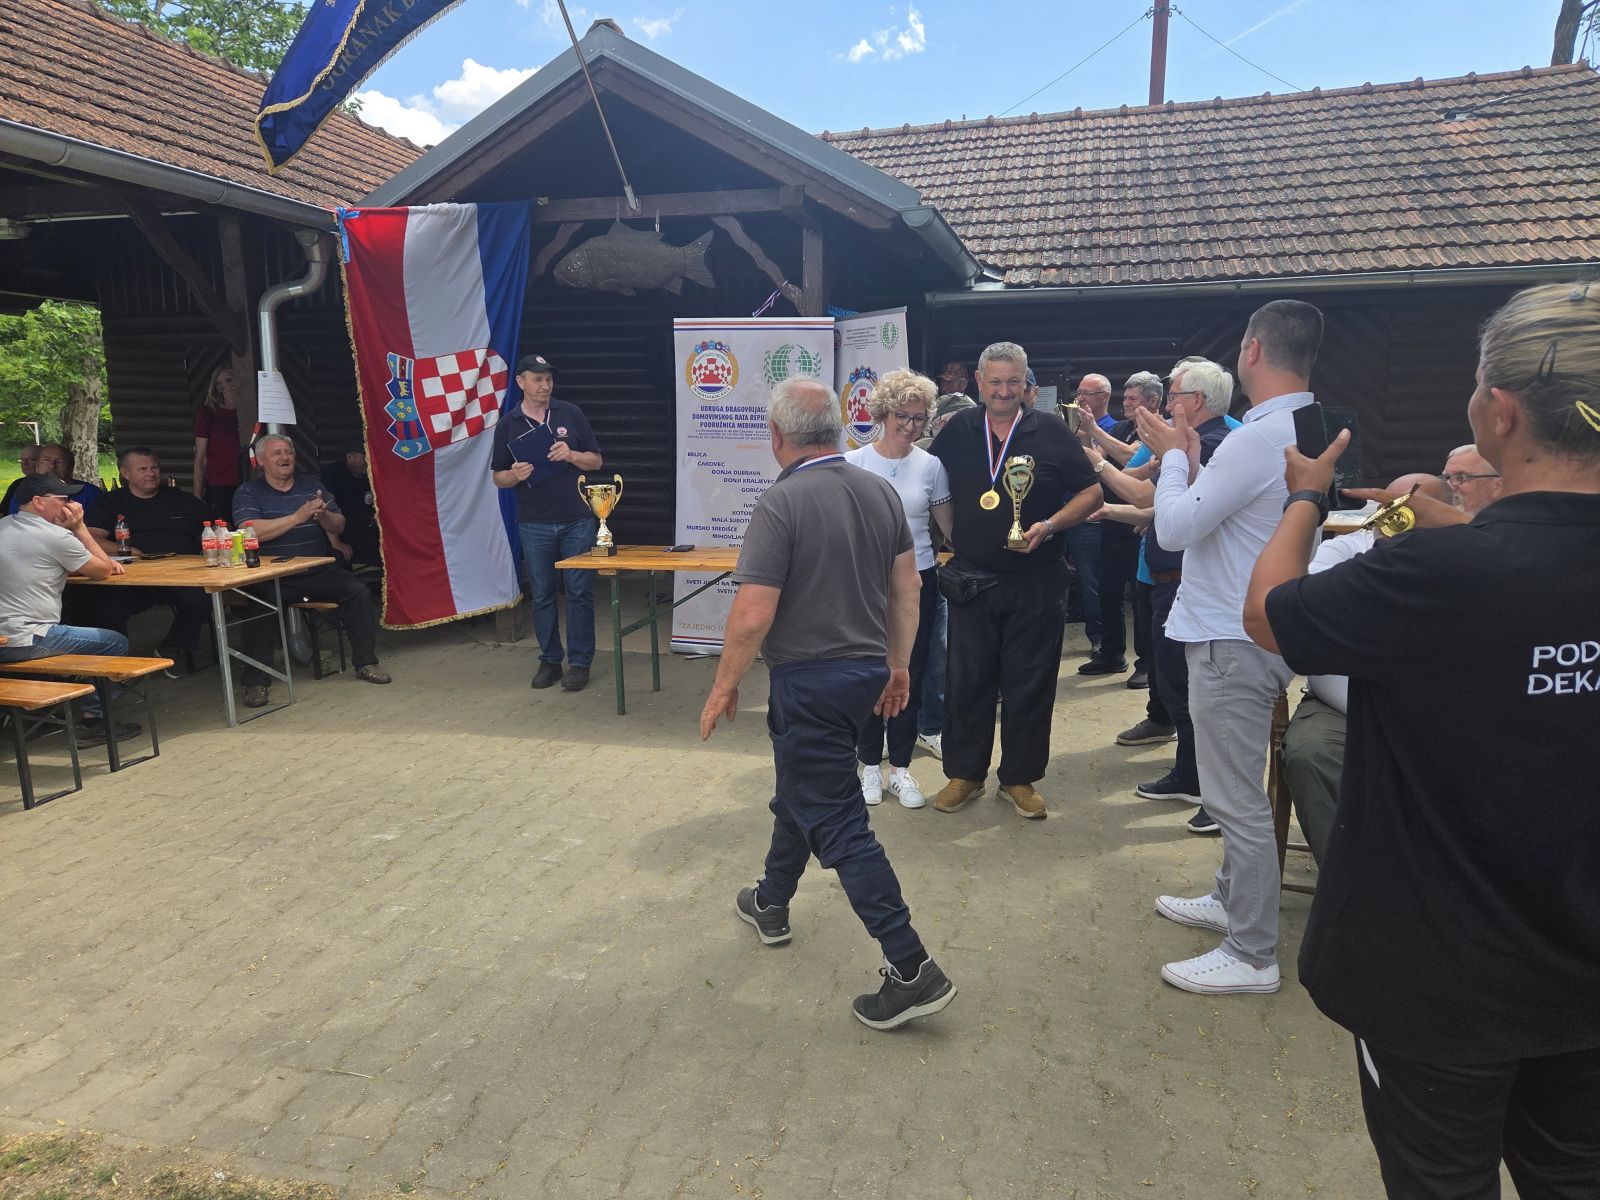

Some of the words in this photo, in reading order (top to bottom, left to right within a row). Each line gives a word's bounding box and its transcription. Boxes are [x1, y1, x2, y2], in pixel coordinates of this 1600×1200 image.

[692, 413, 733, 421] DOMOVINSKOG
[699, 421, 736, 429] PODRUŽNICA
[1532, 640, 1600, 669] POD
